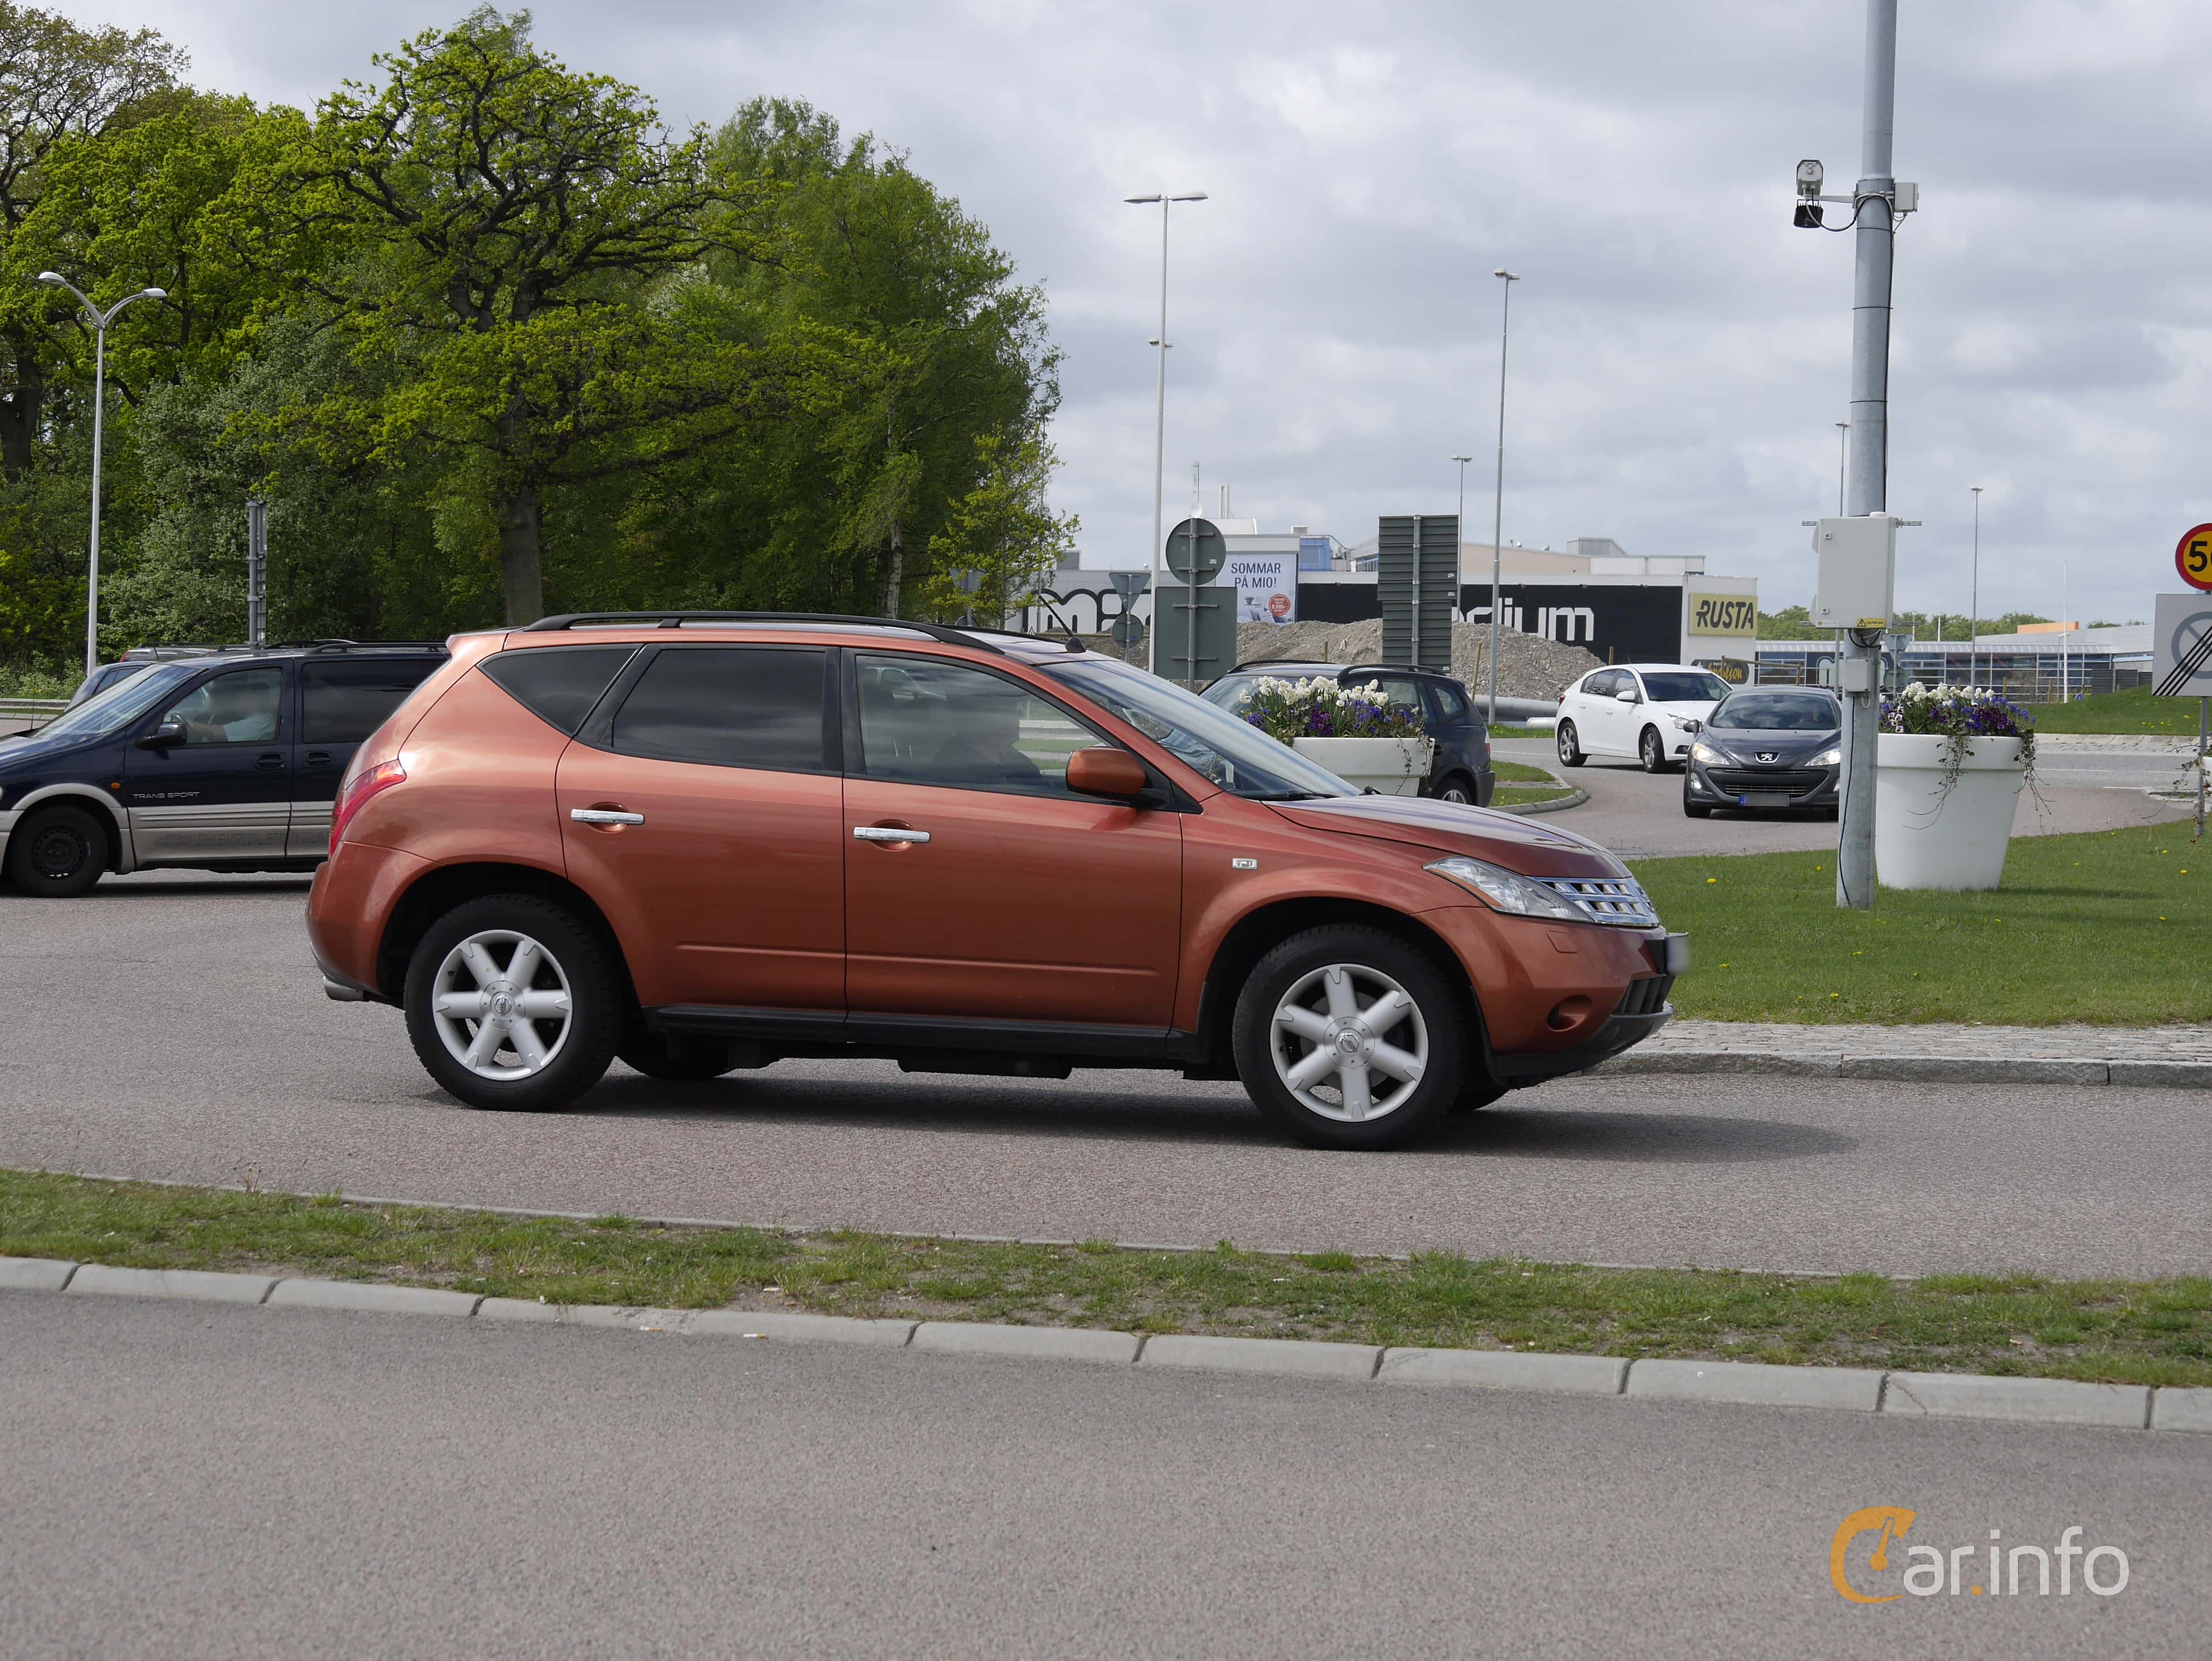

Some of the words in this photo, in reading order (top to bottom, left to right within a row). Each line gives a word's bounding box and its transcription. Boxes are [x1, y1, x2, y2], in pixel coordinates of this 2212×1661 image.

[2188, 540, 2212, 572] 5
[1230, 562, 1281, 574] SOMMAR
[1234, 574, 1248, 588] PÅ
[1252, 577, 1277, 588] MIO!
[1696, 600, 1754, 630] RUSTA
